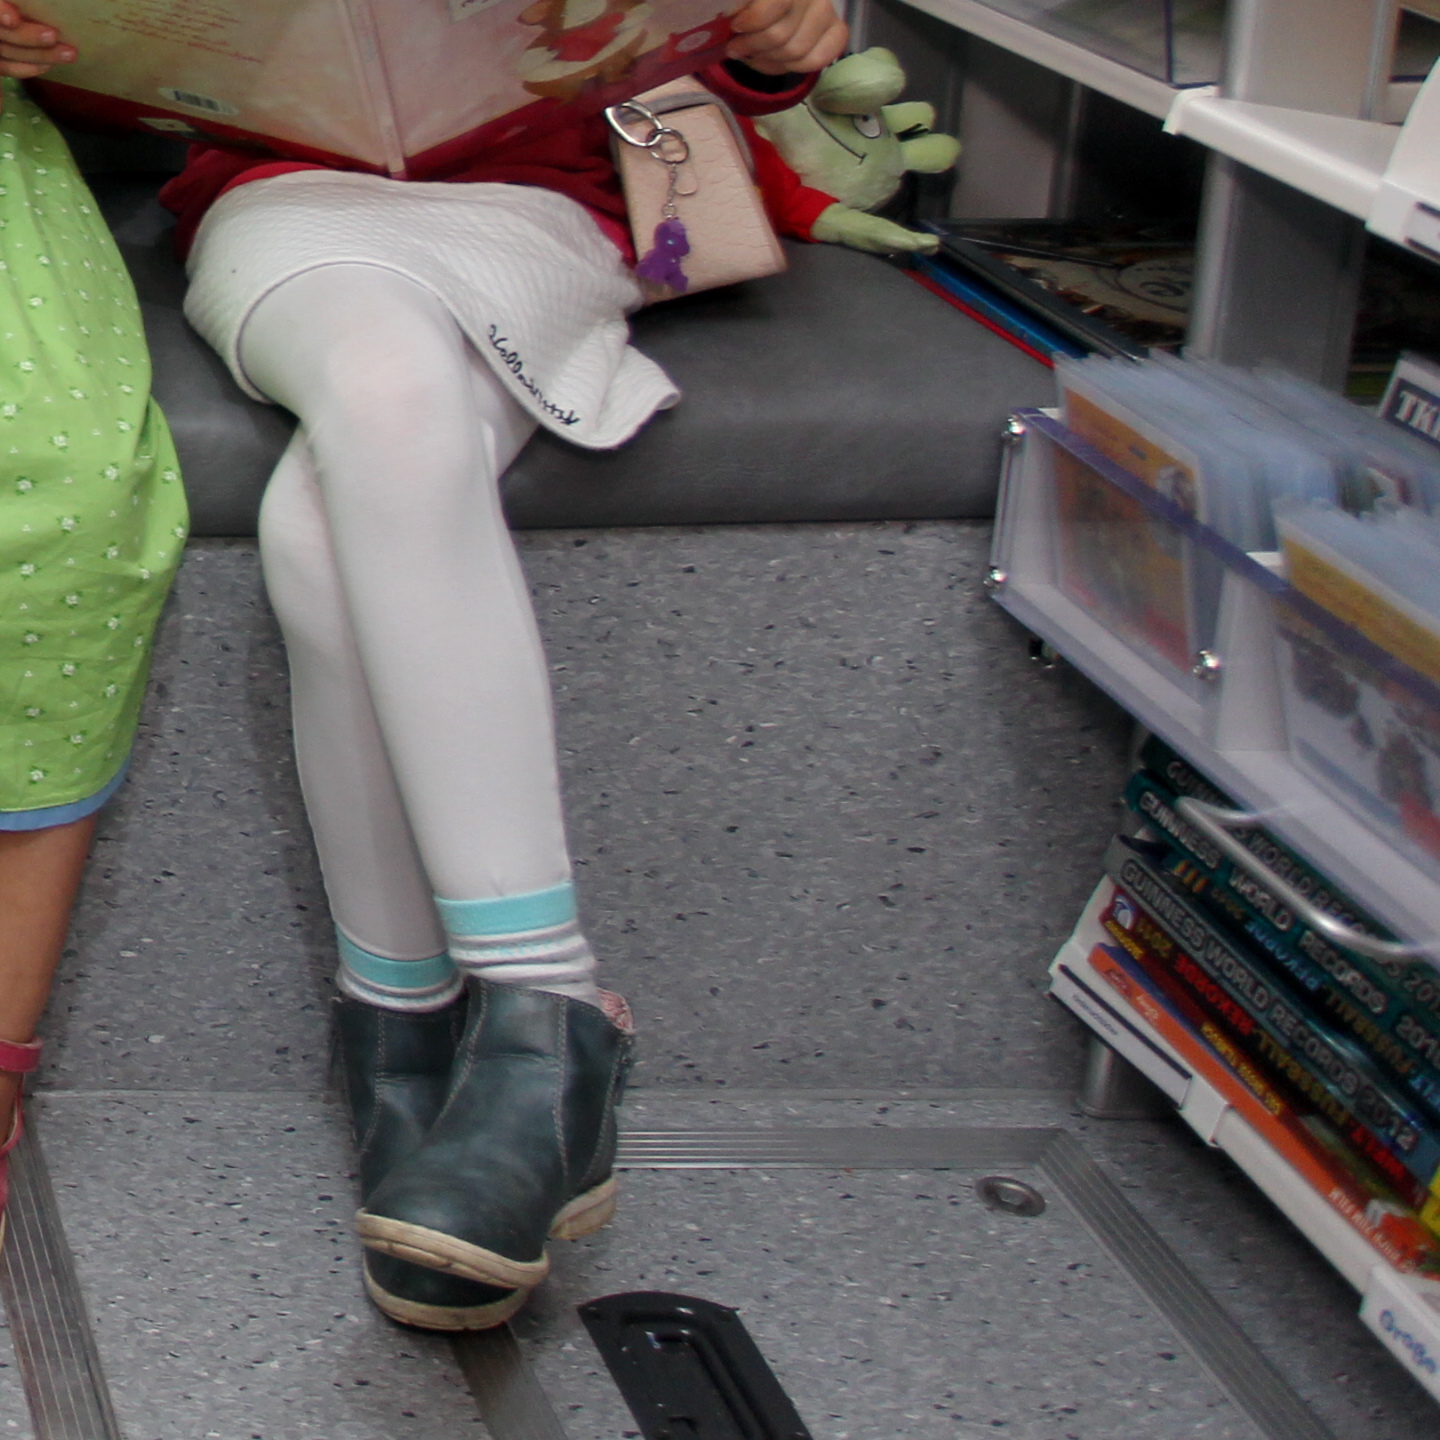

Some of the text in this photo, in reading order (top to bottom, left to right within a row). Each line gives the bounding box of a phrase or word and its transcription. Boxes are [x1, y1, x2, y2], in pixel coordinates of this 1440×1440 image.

[1120, 860, 1206, 951] GUINNESS
[1207, 935, 1271, 1011] WORLD
[1269, 1004, 1359, 1095] RECORDS
[1358, 1083, 1420, 1154] 2012
[1138, 790, 1388, 1014] GUINNESS WORLD RECORDS
